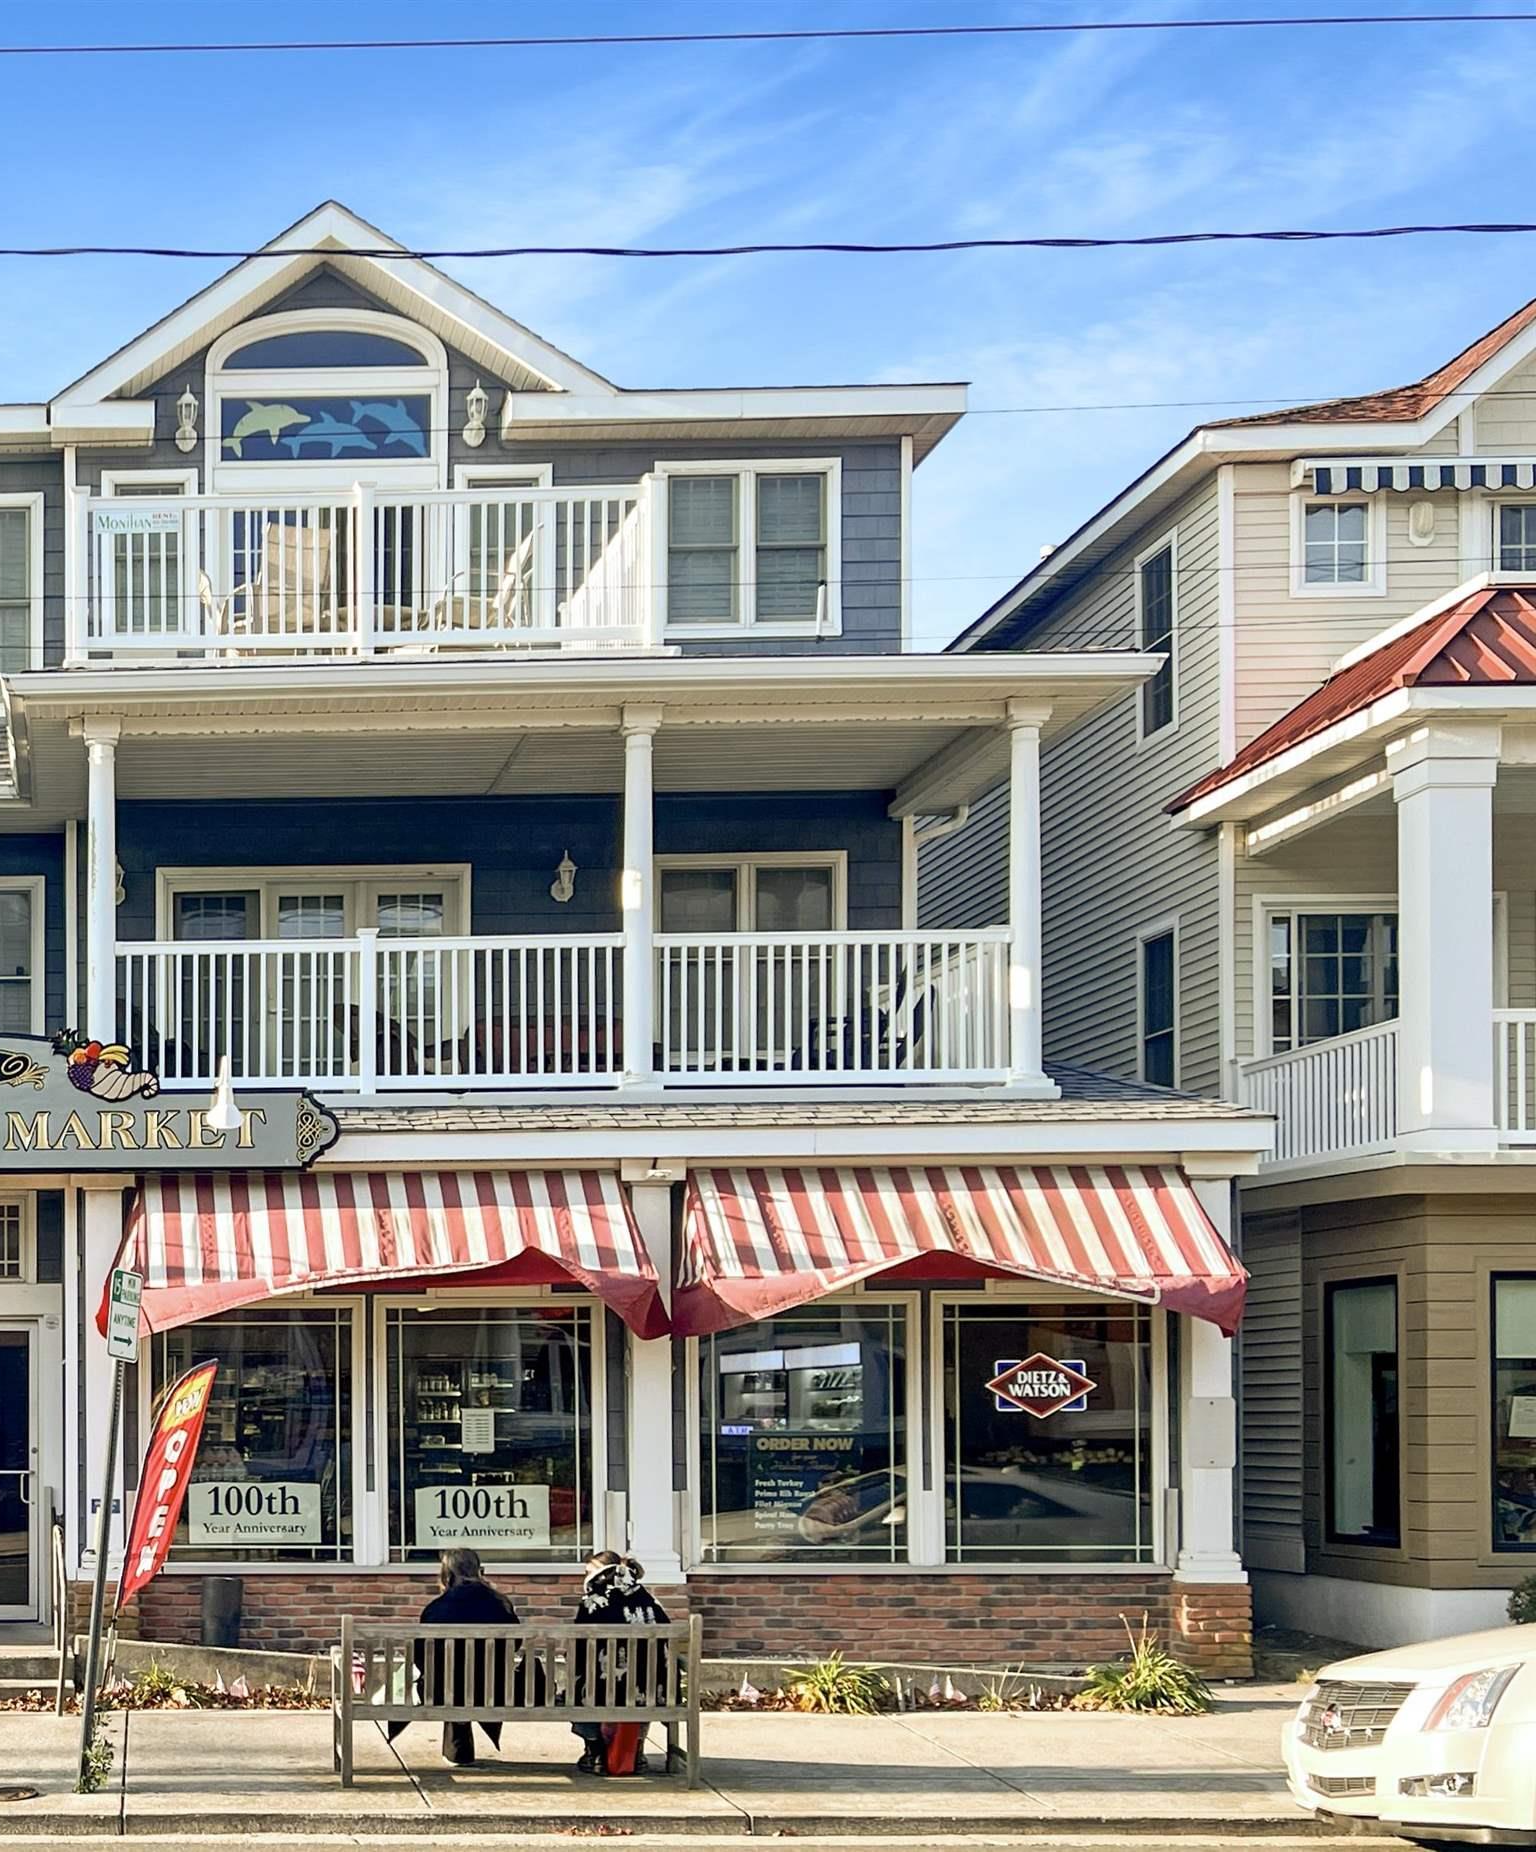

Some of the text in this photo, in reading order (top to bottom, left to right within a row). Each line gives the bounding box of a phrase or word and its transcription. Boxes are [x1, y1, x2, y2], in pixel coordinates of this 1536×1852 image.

[3, 1109, 267, 1152] MARKET
[114, 1279, 121, 1295] 15
[113, 1313, 136, 1328] ANYTIME
[1016, 1371, 1069, 1384] DIETZ &
[1008, 1384, 1071, 1397] WATSON
[756, 1437, 854, 1451] ORDER NOW
[135, 1429, 188, 1578] OPEN
[208, 1485, 301, 1515] 100th
[435, 1489, 530, 1519] 100th
[203, 1522, 306, 1536] Year Anniversary
[430, 1525, 536, 1539] Year Anniversary
